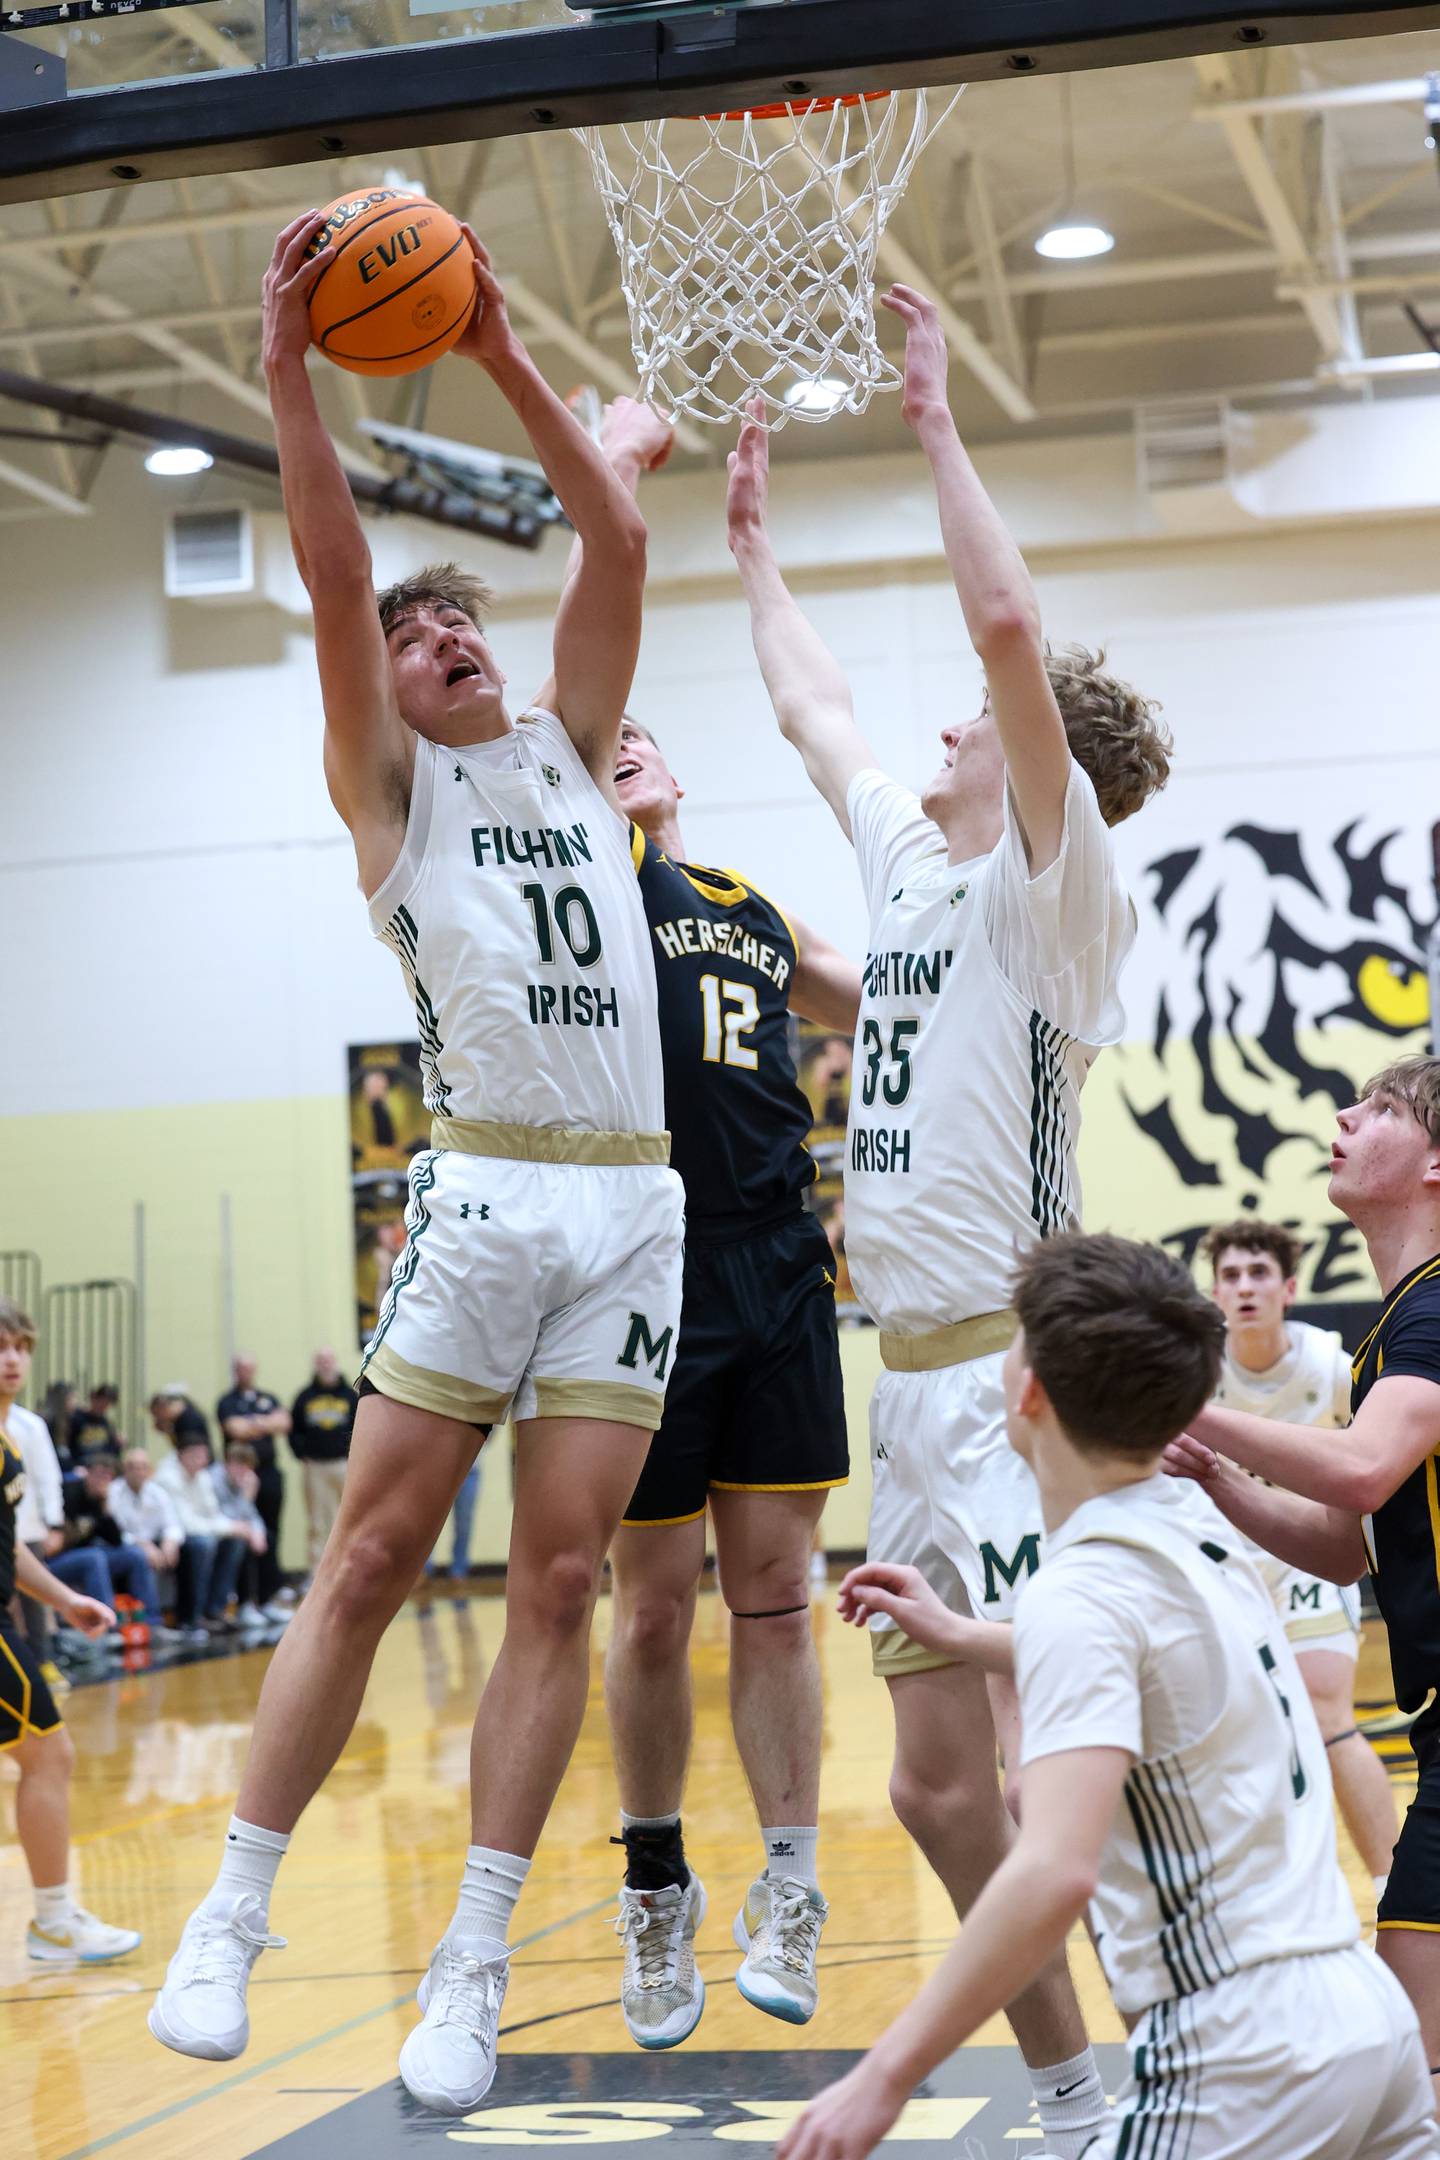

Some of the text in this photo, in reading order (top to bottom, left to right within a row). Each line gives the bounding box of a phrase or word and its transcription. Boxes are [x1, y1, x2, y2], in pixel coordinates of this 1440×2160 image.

[358, 226, 421, 284] EVO
[521, 881, 604, 970] 10
[654, 918, 790, 991] HERSCHER
[527, 984, 620, 1028] IRISH
[699, 973, 761, 1071] 12
[860, 1016, 920, 1109] 35
[851, 1128, 911, 1174] IRISH
[616, 1310, 674, 1382] M
[979, 1532, 1041, 1604] M
[1289, 1582, 1321, 1611] M
